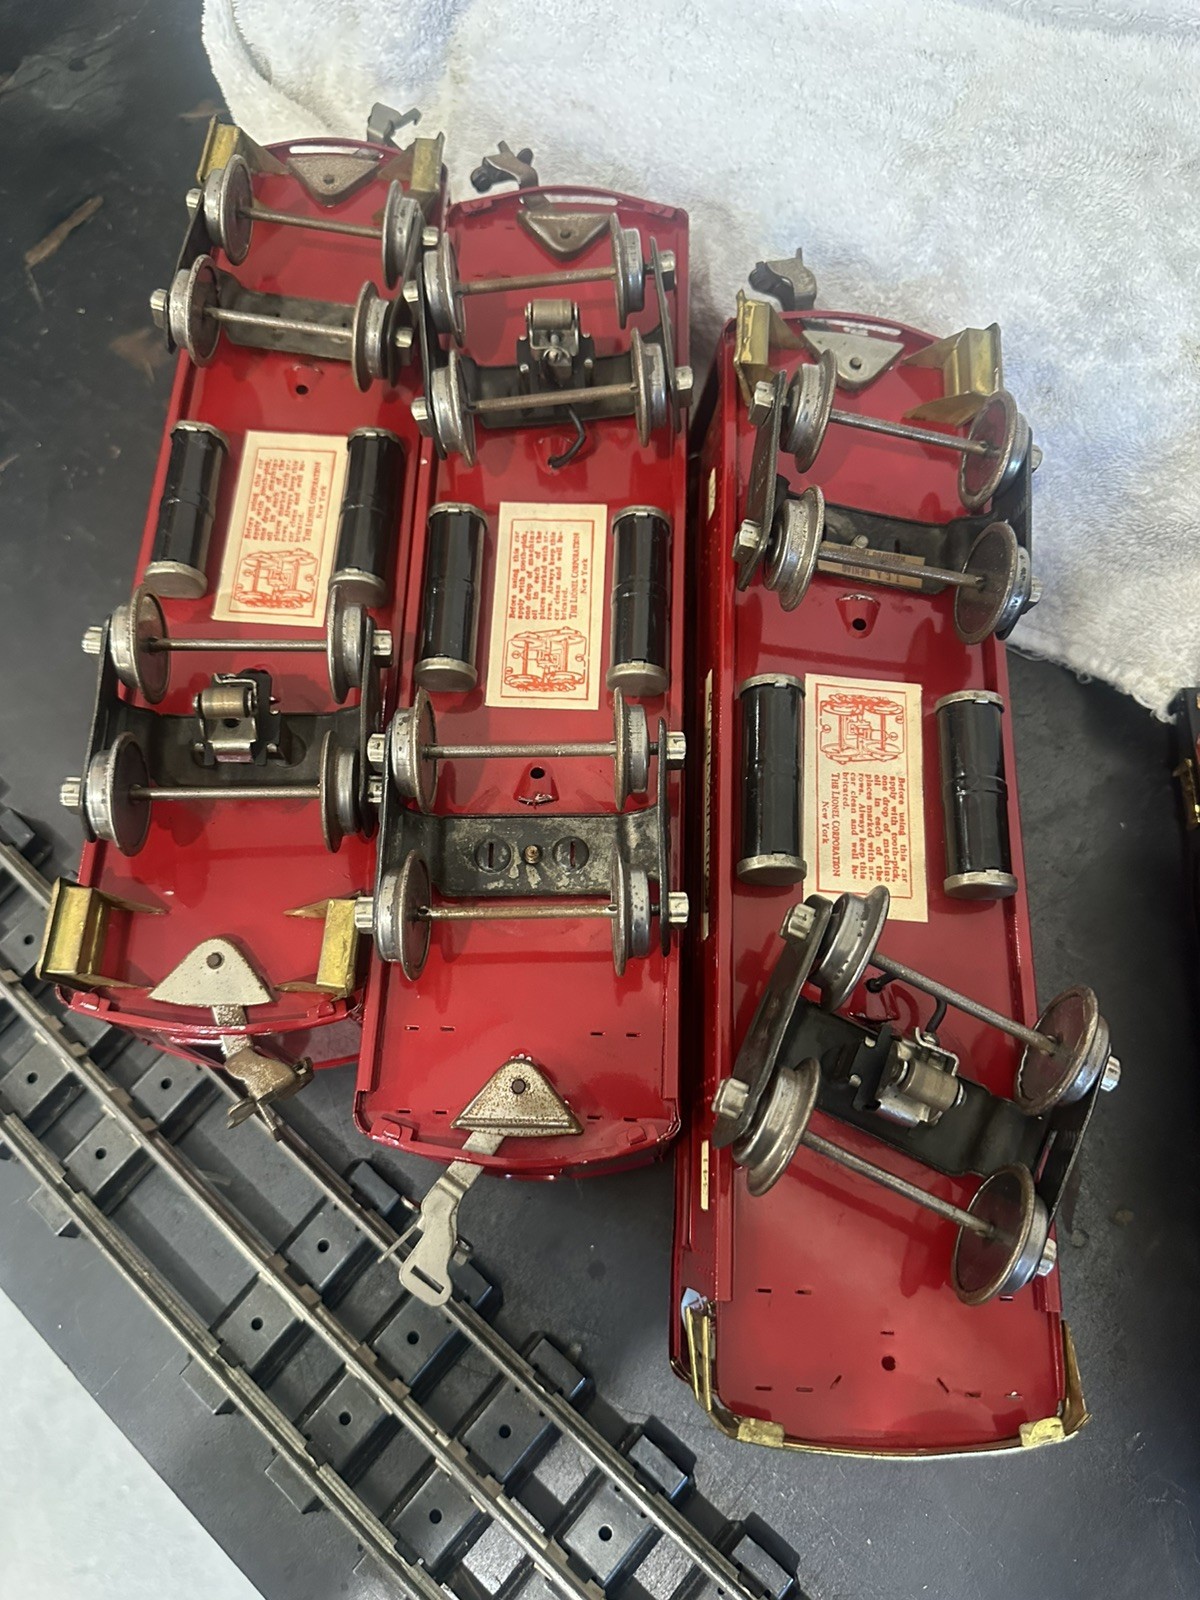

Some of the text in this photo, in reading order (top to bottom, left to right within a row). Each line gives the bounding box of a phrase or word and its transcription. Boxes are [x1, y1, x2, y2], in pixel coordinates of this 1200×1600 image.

[874, 797, 880, 807] in
[881, 796, 890, 817] drop
[831, 772, 840, 876] THE LIONEL CORPORATION
[857, 803, 865, 833] Always
[883, 823, 890, 832] of
[858, 837, 866, 858] keep
[876, 846, 882, 855] of
[890, 832, 899, 882] tooth-pick,
